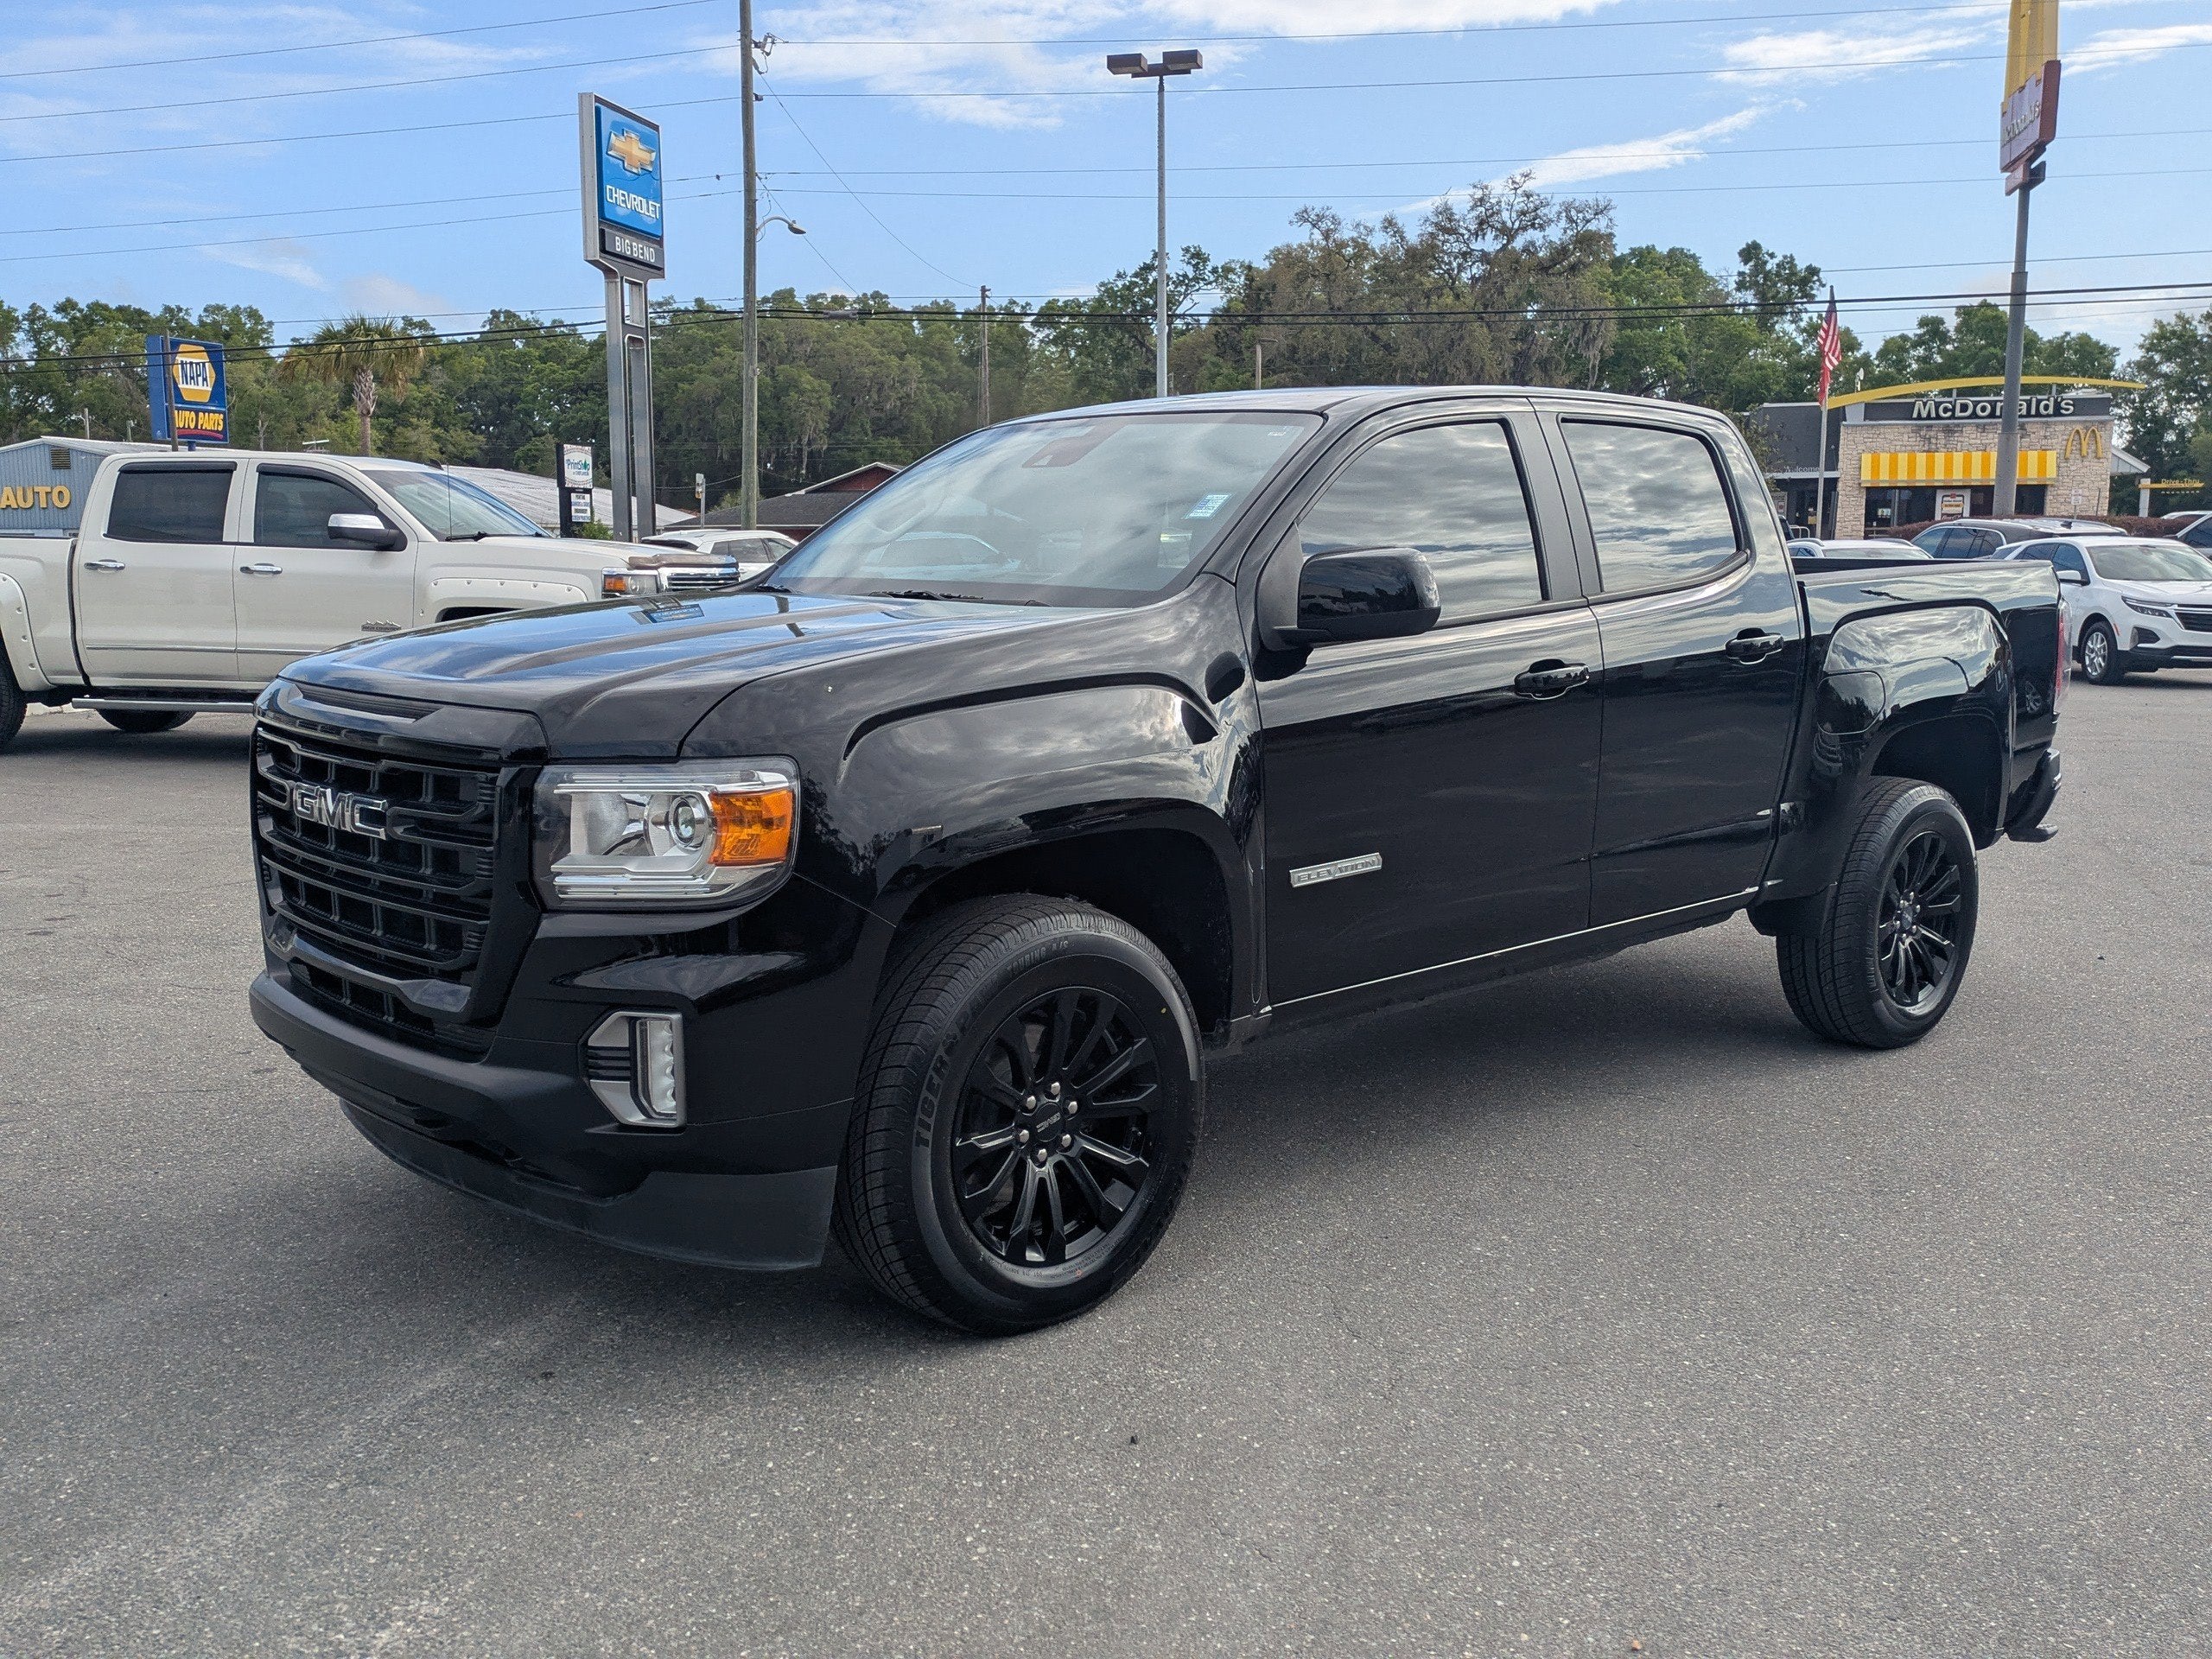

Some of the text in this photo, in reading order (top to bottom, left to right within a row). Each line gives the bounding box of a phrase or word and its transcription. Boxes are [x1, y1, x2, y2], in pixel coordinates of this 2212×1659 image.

[607, 184, 660, 219] CHEVROLET
[614, 236, 655, 263] BIG BEND
[180, 359, 209, 387] NAPA
[175, 410, 224, 431] AUTO PARTS
[0, 486, 71, 509] AUTO
[294, 782, 388, 840] GMC
[1296, 856, 1376, 882] ELEVATION
[1007, 947, 1046, 973] TOURING
